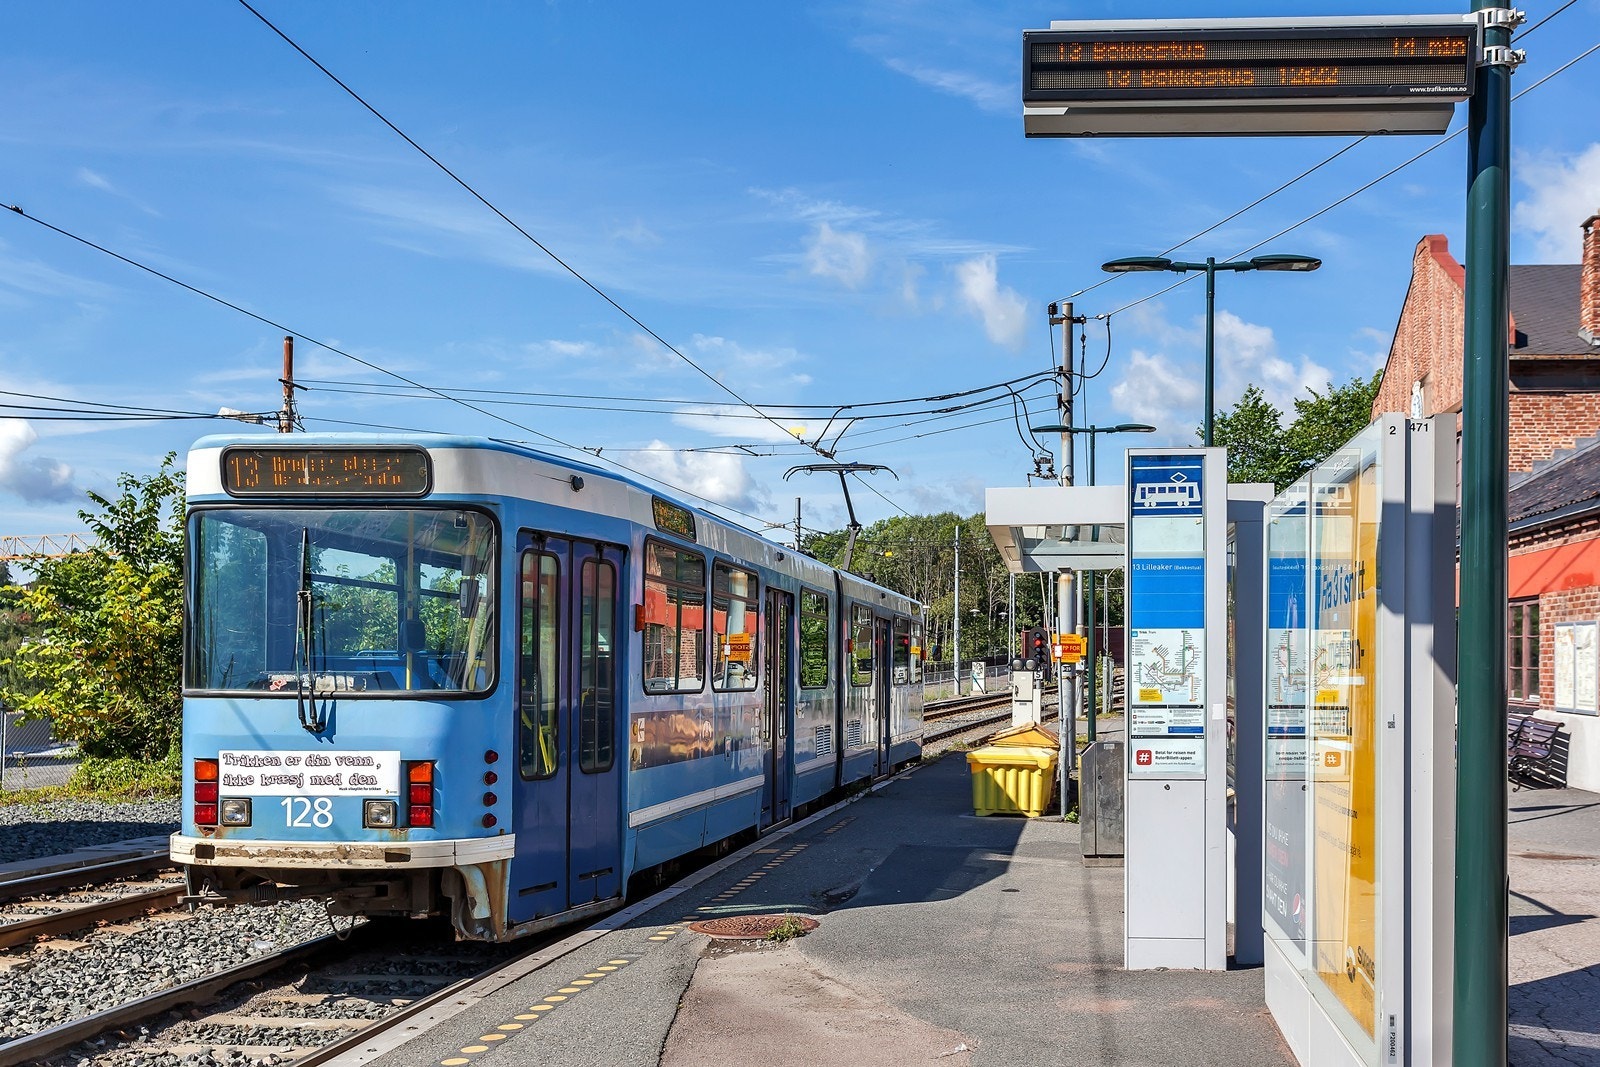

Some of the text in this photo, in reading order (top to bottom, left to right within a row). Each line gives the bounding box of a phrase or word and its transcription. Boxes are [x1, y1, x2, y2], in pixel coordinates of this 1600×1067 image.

[1059, 42, 1082, 60] 13
[1393, 37, 1415, 55] 14
[1409, 85, 1467, 93] www.trafikanten.no
[1389, 425, 1397, 435] 2
[1409, 423, 1428, 432] 471
[231, 456, 259, 488] 13
[1132, 563, 1140, 571] 13
[1142, 563, 1172, 571] Lilleaker
[222, 752, 282, 767] Trikken
[285, 755, 301, 766] er
[305, 753, 331, 767] din
[222, 772, 378, 788] ikke kræsj med den
[280, 796, 333, 828] 128
